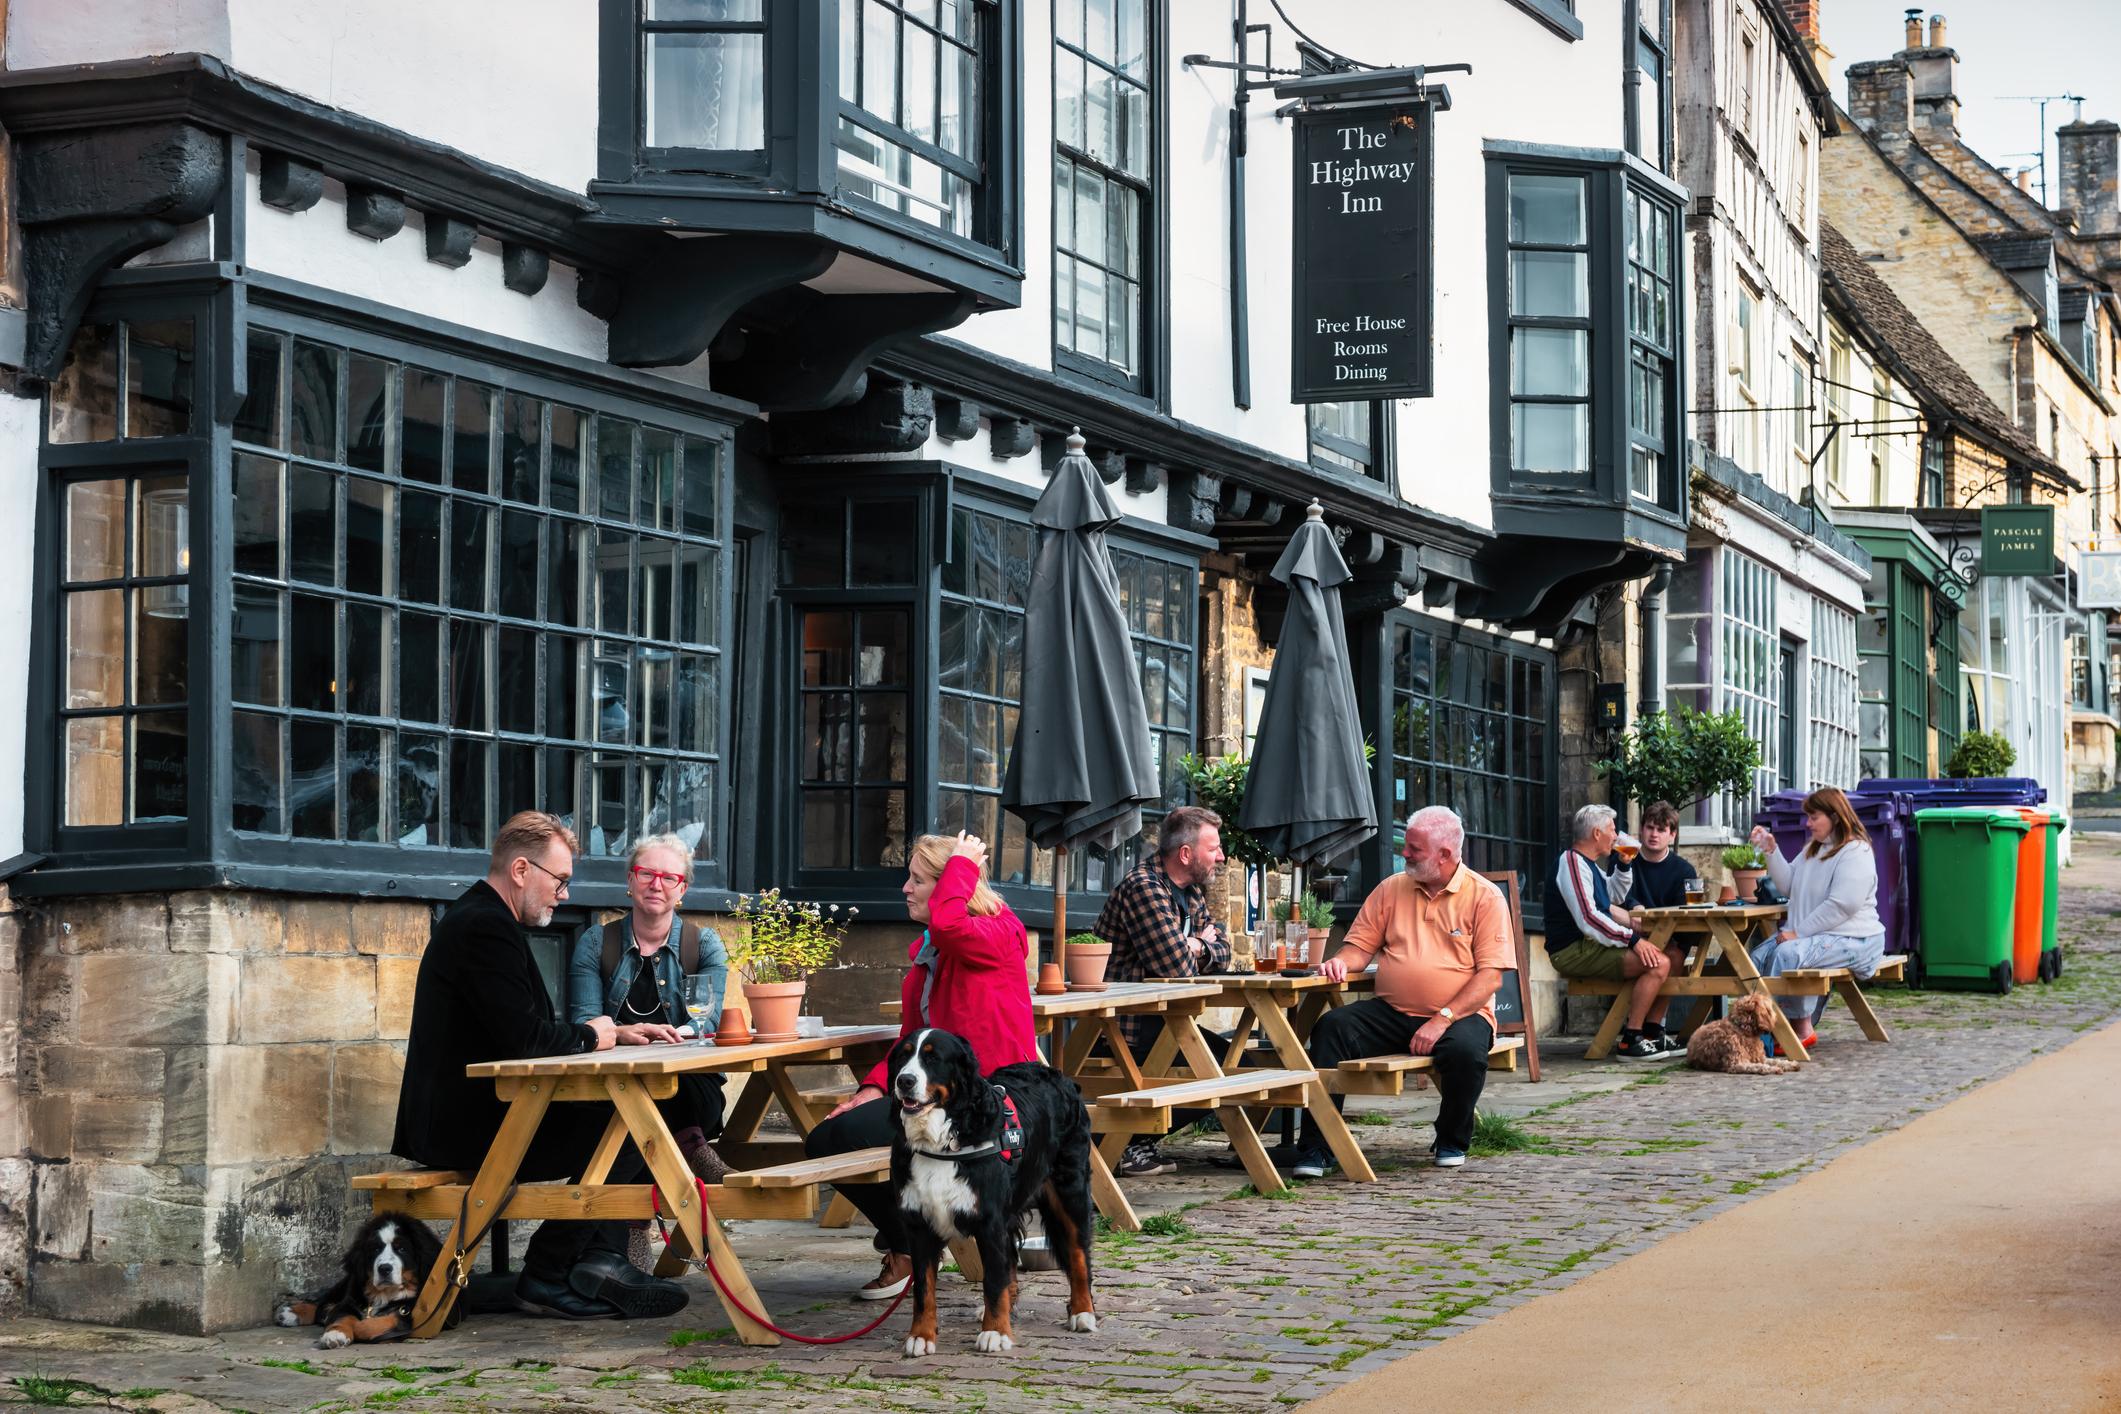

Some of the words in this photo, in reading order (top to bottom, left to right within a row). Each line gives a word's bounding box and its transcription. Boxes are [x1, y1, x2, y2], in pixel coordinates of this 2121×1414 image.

[1337, 127, 1387, 150] The
[1310, 158, 1415, 187] Highway
[1341, 191, 1383, 214] Inn
[1316, 318, 1350, 334] Free
[1355, 315, 1406, 331] House
[1334, 341, 1388, 357] Rooms
[1335, 363, 1388, 381] Dining
[1994, 528, 2042, 536] PASCALE
[2001, 543, 2035, 551] JAMES
